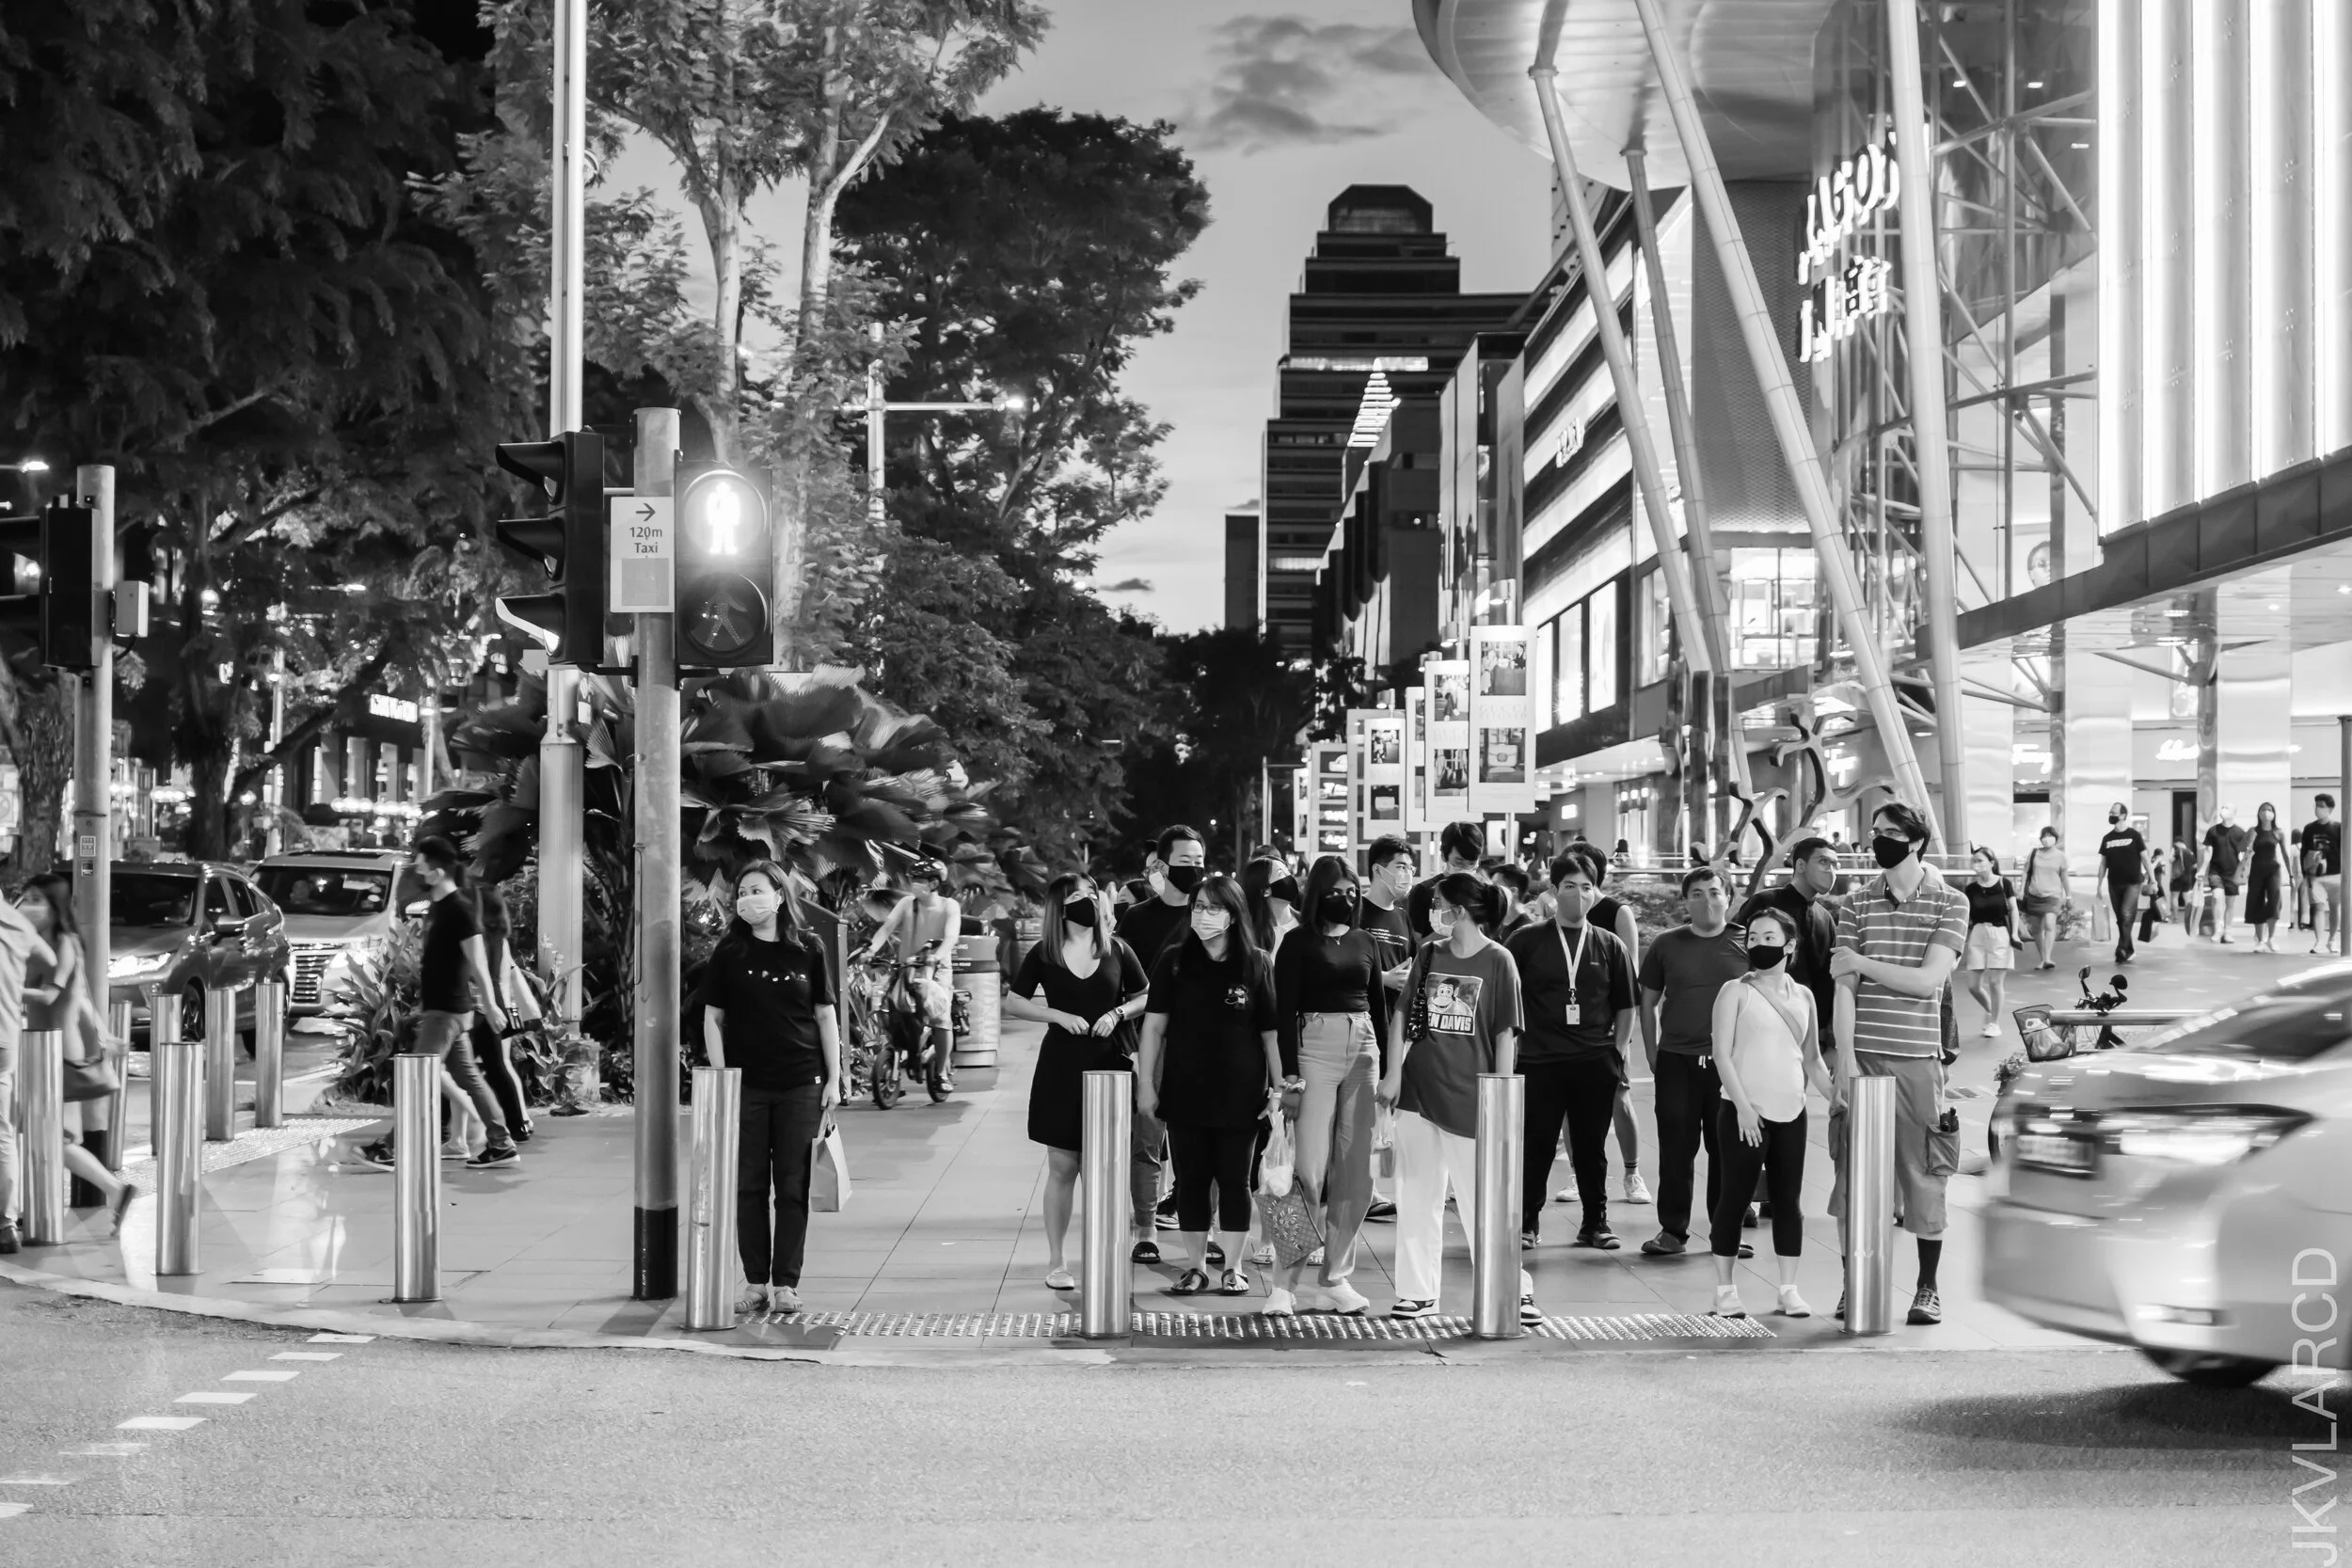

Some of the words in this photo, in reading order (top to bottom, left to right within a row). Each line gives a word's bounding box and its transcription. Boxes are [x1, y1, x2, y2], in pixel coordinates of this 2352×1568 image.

[629, 527, 662, 538] 120m
[634, 542, 659, 553] Taxi
[1440, 1015, 1471, 1031] DAVIS
